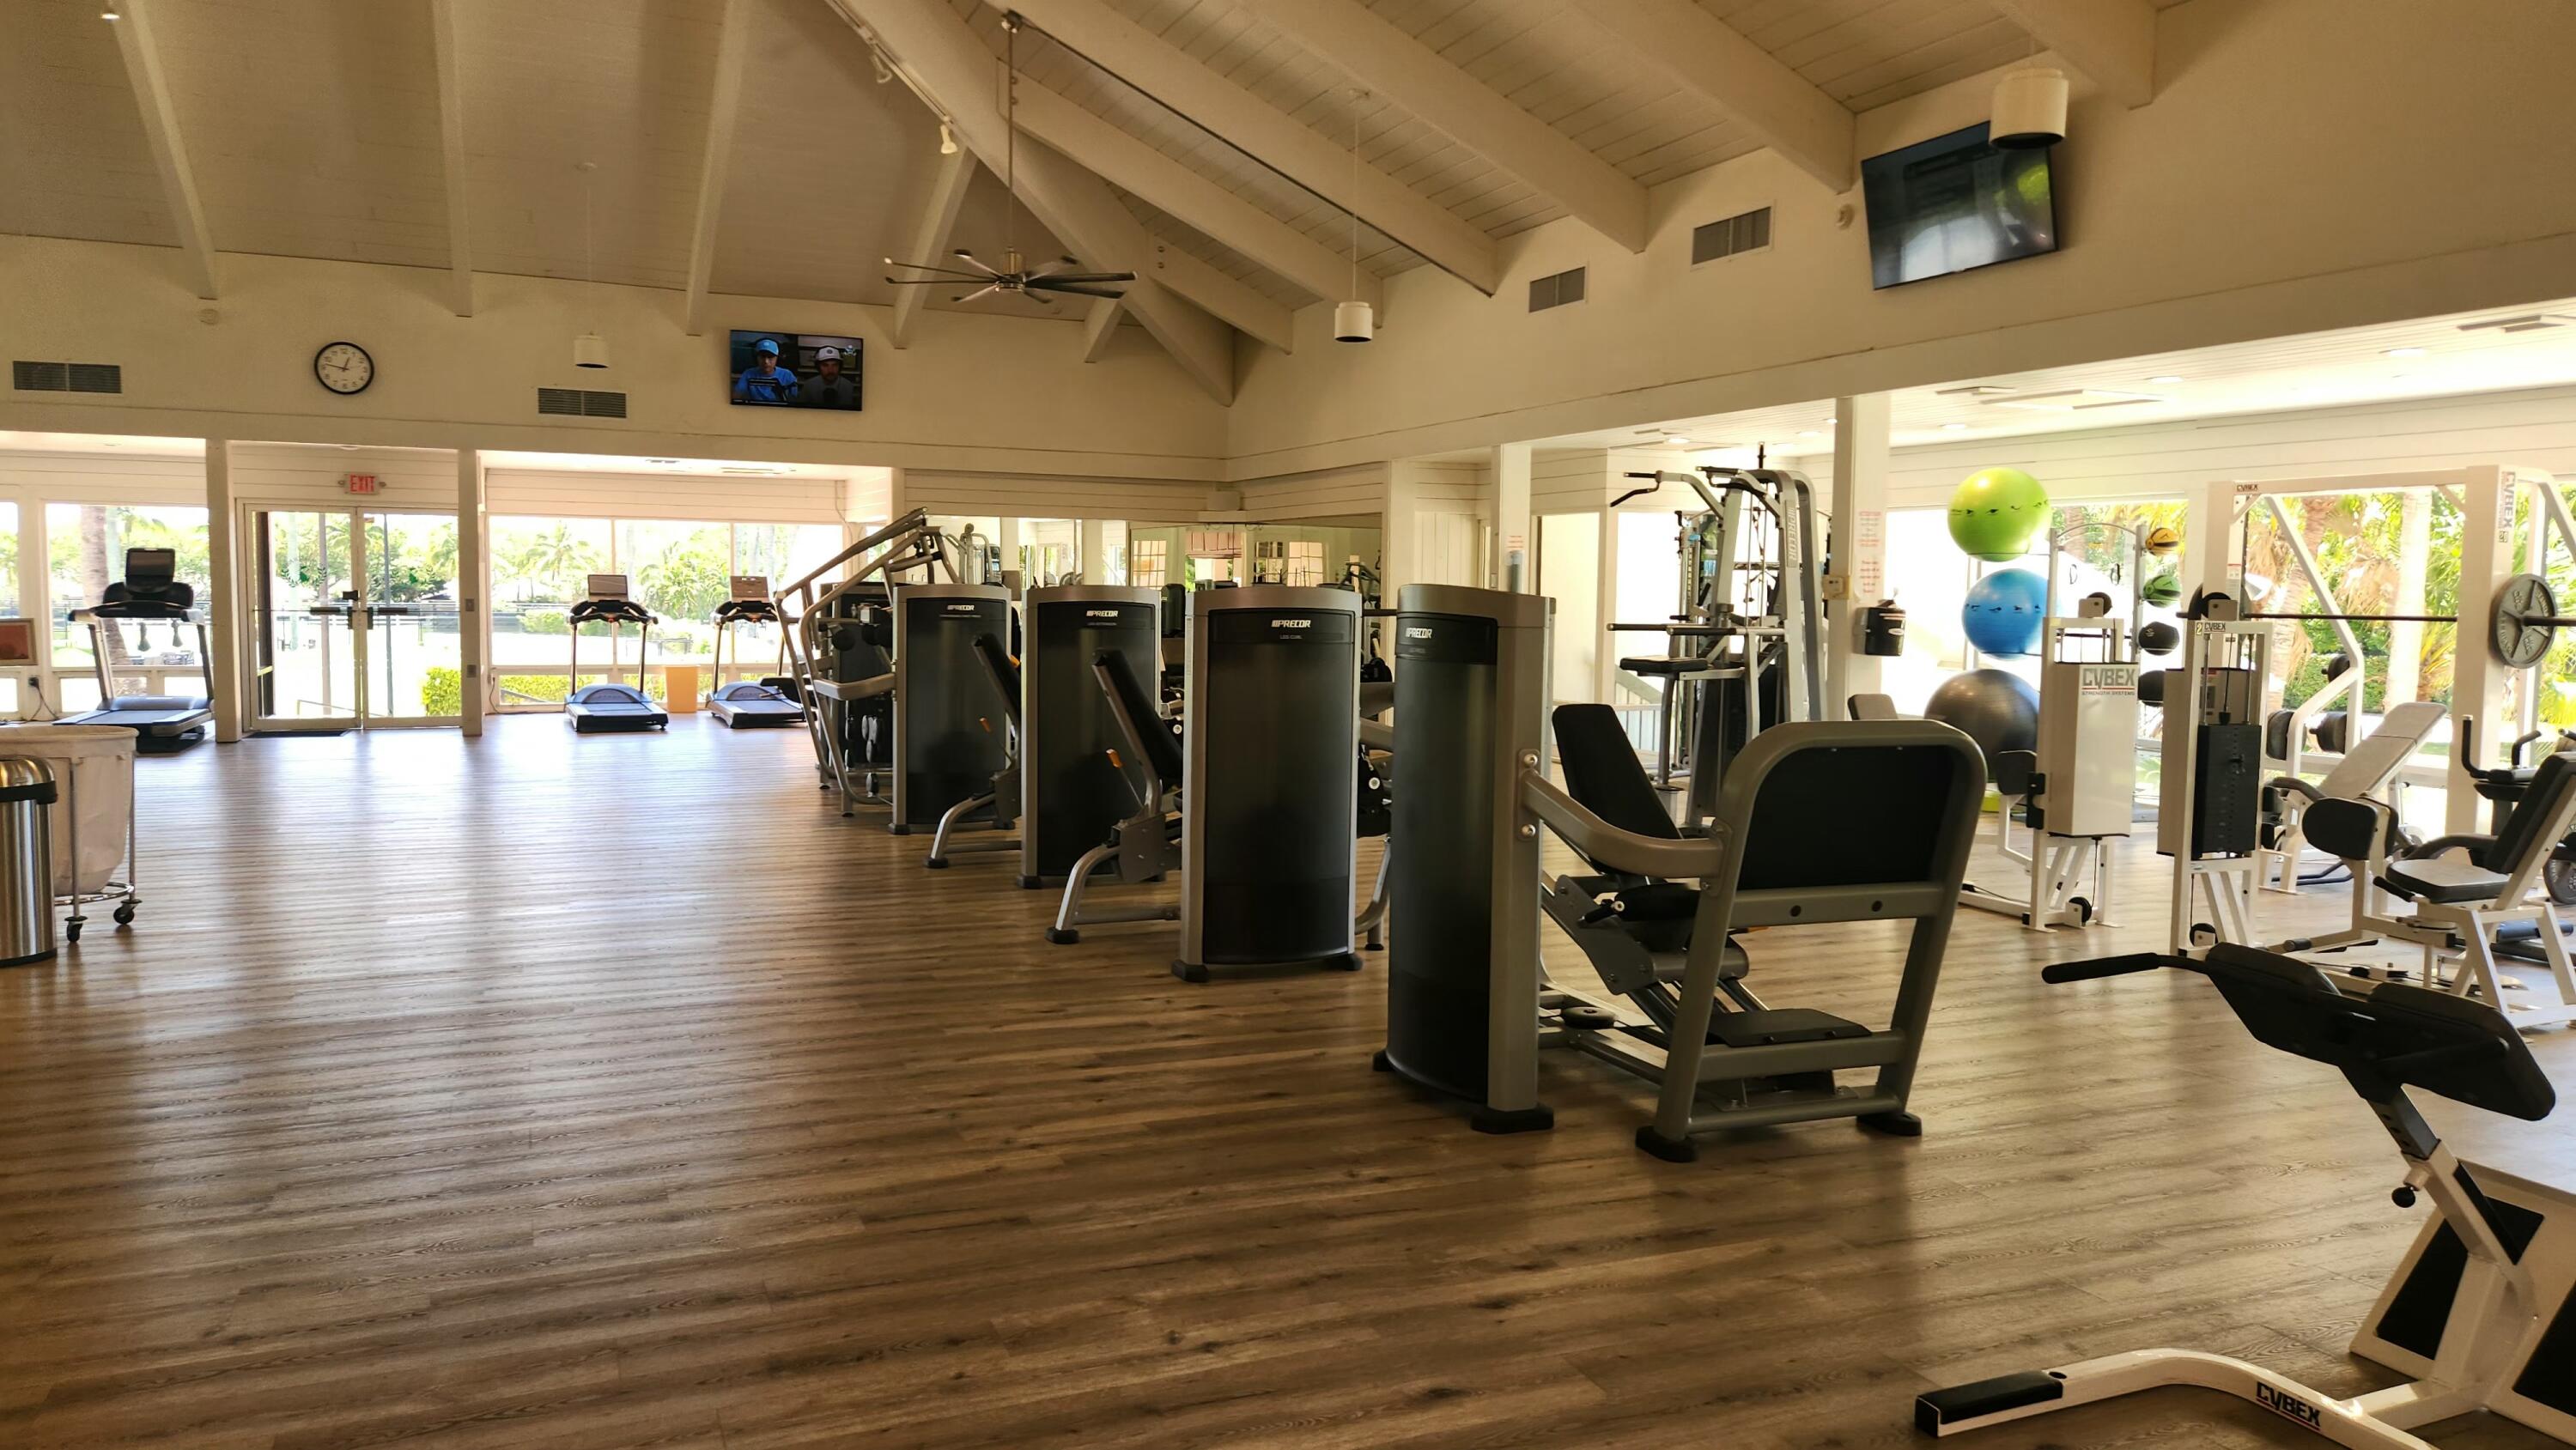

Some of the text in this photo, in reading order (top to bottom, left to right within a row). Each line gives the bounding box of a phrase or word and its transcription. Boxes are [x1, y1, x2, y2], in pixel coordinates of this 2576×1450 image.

[350, 474, 377, 492] EXIT
[1787, 516, 1798, 561] PRECOR
[1277, 620, 1311, 628] PRECOR
[1408, 628, 1432, 639] PRECOR
[2082, 668, 2136, 689] CYBEX
[2256, 1381, 2321, 1428] CYBEX
